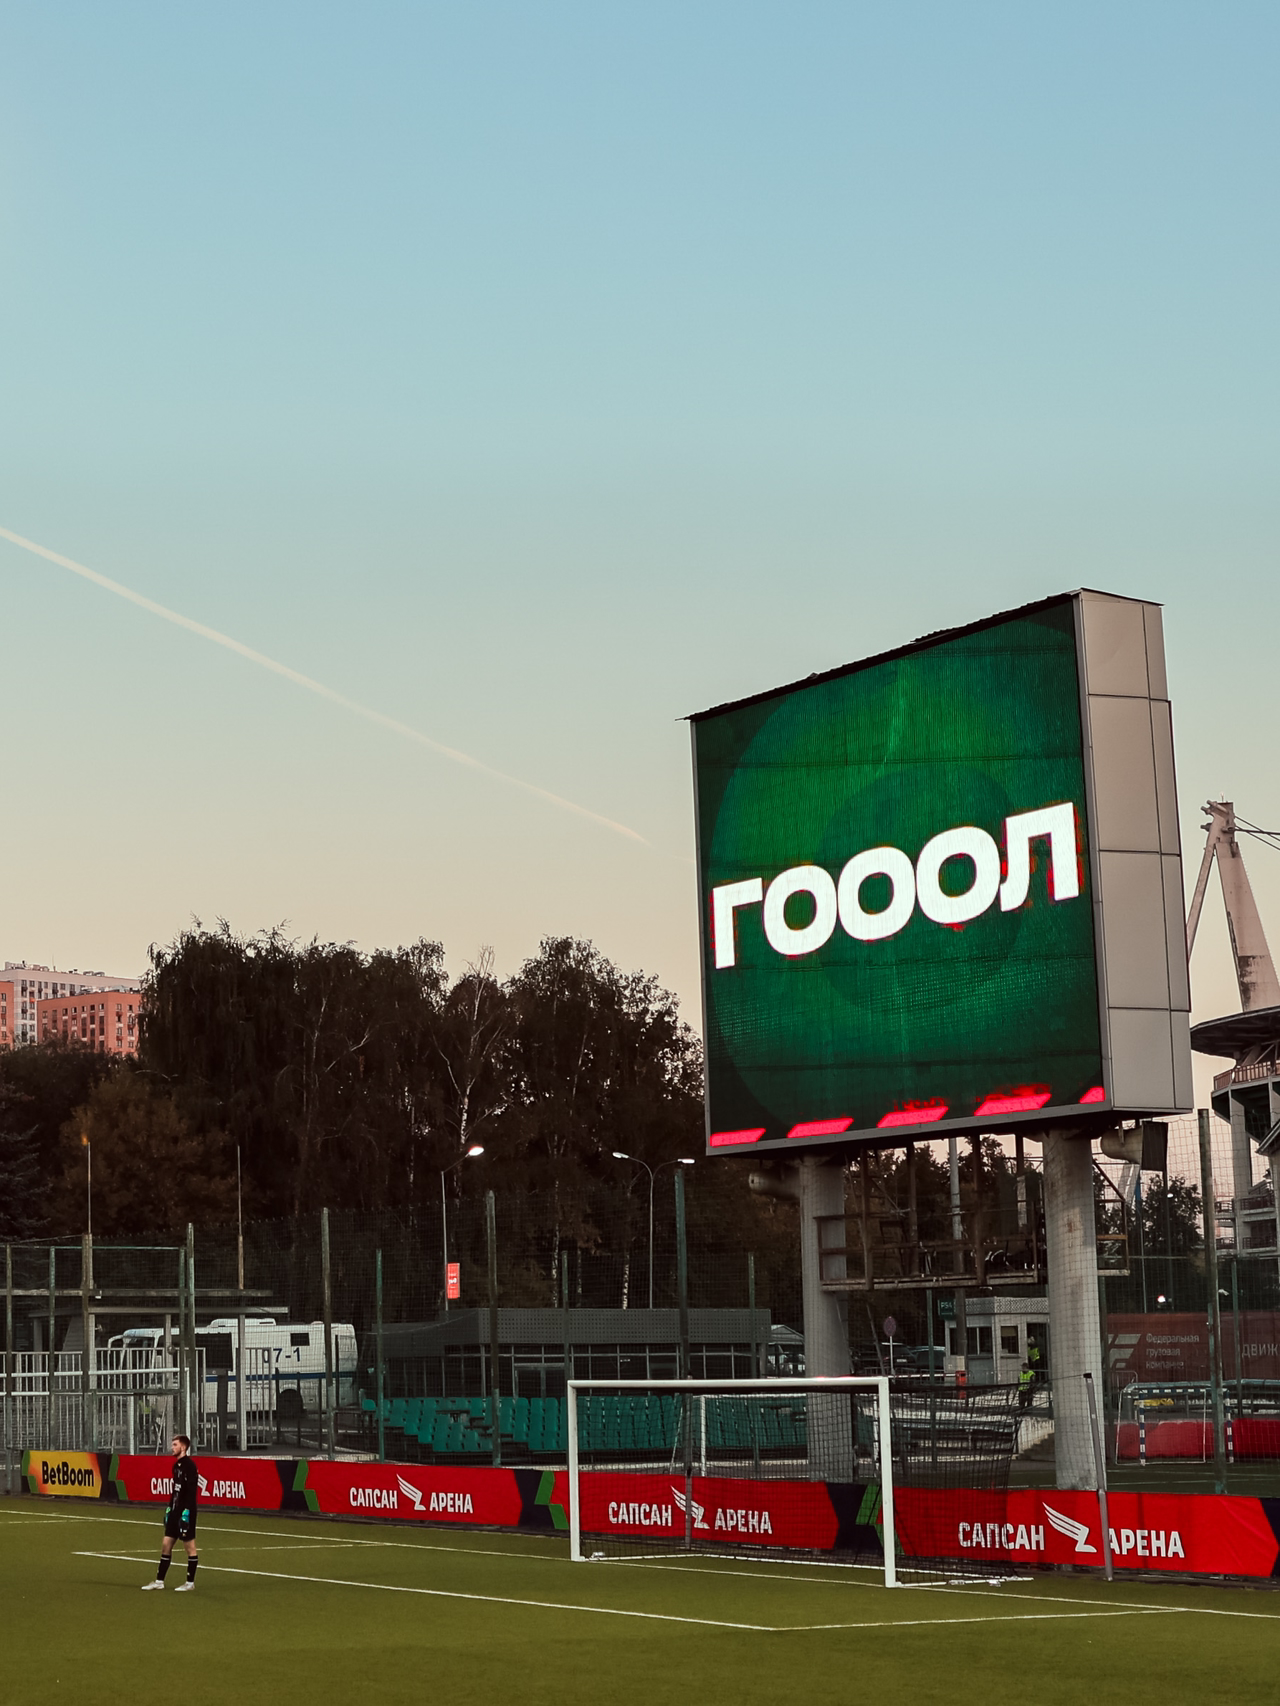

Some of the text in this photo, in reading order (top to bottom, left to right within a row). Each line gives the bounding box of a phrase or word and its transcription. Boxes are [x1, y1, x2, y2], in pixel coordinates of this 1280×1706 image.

[713, 802, 1079, 969] ГОООЛ
[1146, 1333, 1200, 1344] Федеральная
[1146, 1347, 1181, 1357] грузовая
[42, 1460, 95, 1487] BetBoom
[150, 1477, 246, 1499] САПС АРЕНА
[350, 1487, 474, 1514] САПСАН АРЕНА
[608, 1501, 773, 1535] САПСАН АРЕНА
[958, 1522, 1186, 1559] САПСАН АРЕНА
